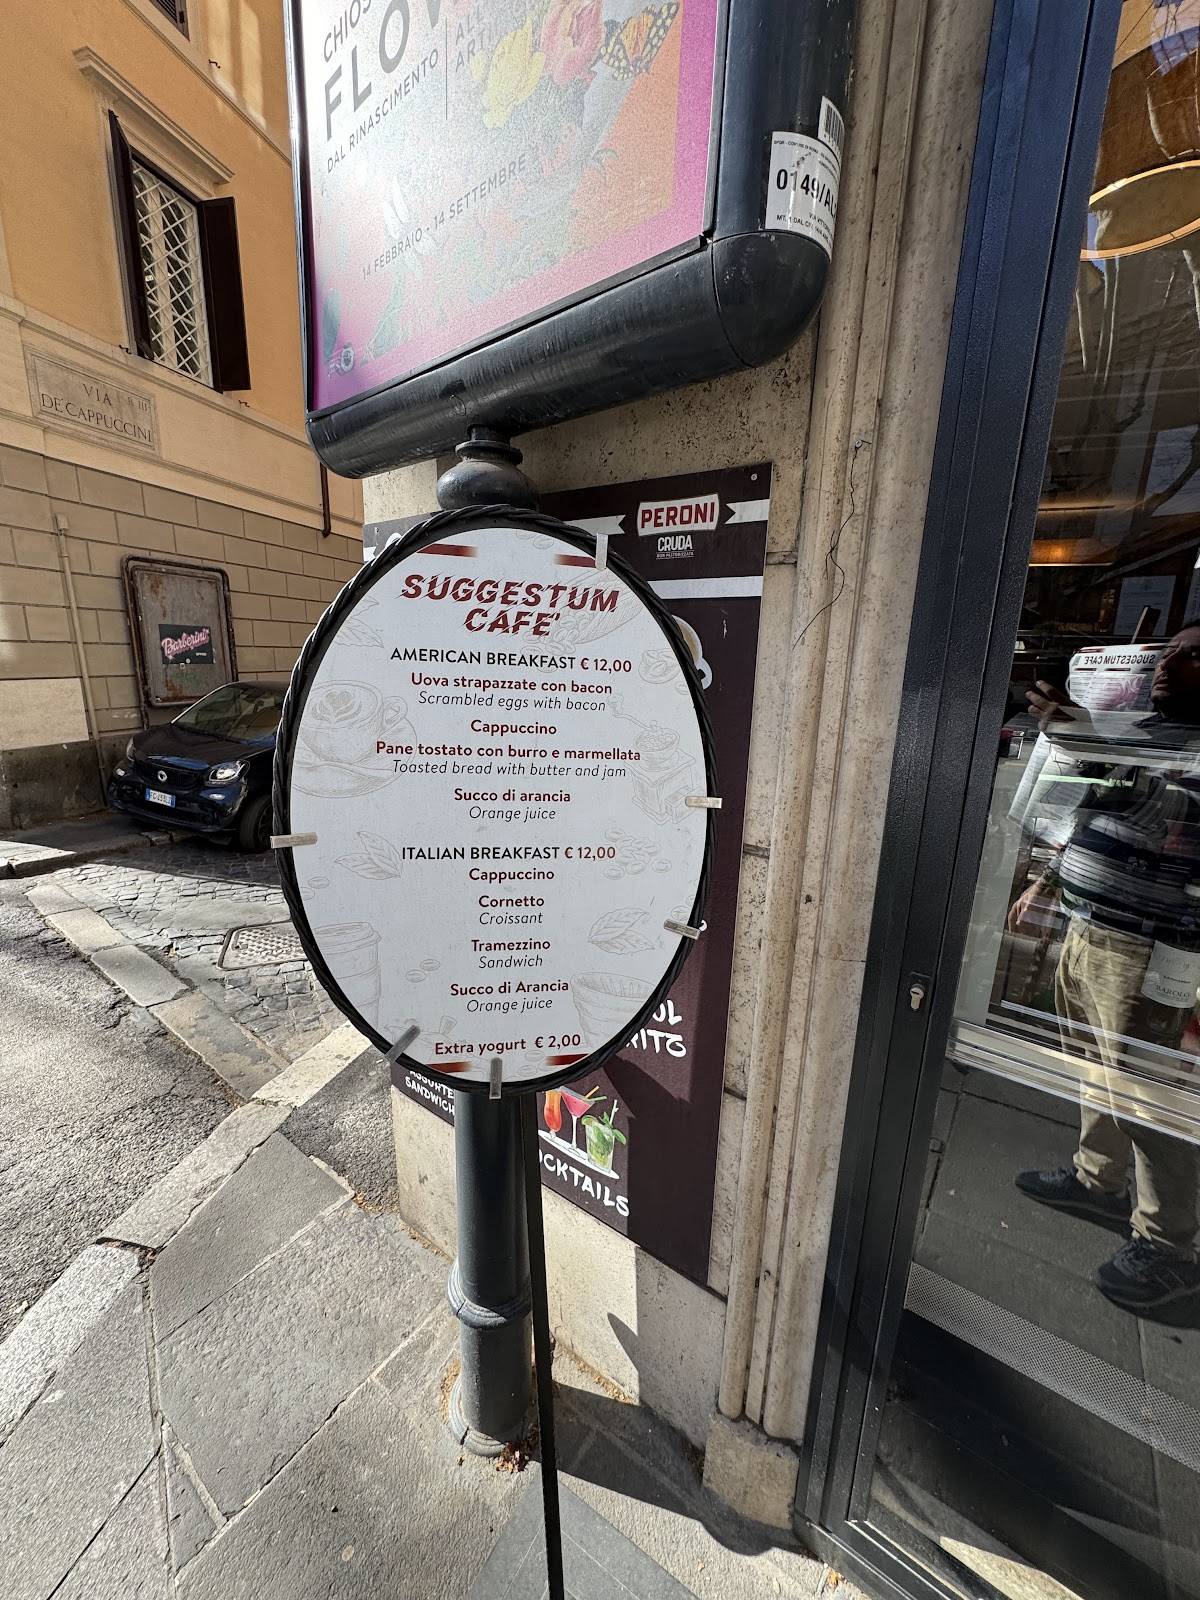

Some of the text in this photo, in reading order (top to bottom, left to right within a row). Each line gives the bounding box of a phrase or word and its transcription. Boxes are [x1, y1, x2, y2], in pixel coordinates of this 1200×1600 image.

[327, 48, 438, 173] DAL RINASCIMENTO
[363, 264, 372, 281] 14
[374, 228, 423, 272] FEBBRAIO
[434, 211, 445, 230] 14
[449, 154, 526, 219] SETTEMBRE
[82, 383, 112, 406] VIA
[65, 402, 152, 442] CAPPUCCINI
[641, 502, 715, 528] PERONI
[657, 535, 693, 551] CRUDA
[400, 574, 619, 612] SUGGESTUM
[464, 608, 561, 636] CAFE'
[161, 628, 210, 660] Barberini
[390, 648, 632, 673] AMERICAN BREAKFAST € 12,00
[411, 673, 612, 694] Uova strapazzate con bacon
[418, 691, 606, 712] Scrambled eggs with bacon
[470, 719, 557, 736] Cappuccino
[376, 741, 641, 761] Pane tostato con burro e marmellata
[394, 760, 626, 780] Toasted bread with butter and jam
[454, 788, 571, 802] Succo di arancia
[469, 806, 556, 822] Orange juice
[402, 847, 616, 861] ITALIAN BREAKFAST € 12,00
[469, 867, 555, 884] Cappuccino
[478, 895, 545, 907] Cornetto
[479, 912, 543, 925] Croissant
[471, 939, 551, 952] Tramezzino
[478, 955, 543, 969] Sandwich
[450, 980, 569, 996] Succo di Arancia
[467, 999, 553, 1014] Orange juice
[435, 1034, 581, 1056] Extra yogurt € 2,00
[405, 1076, 455, 1116] SANDWICH
